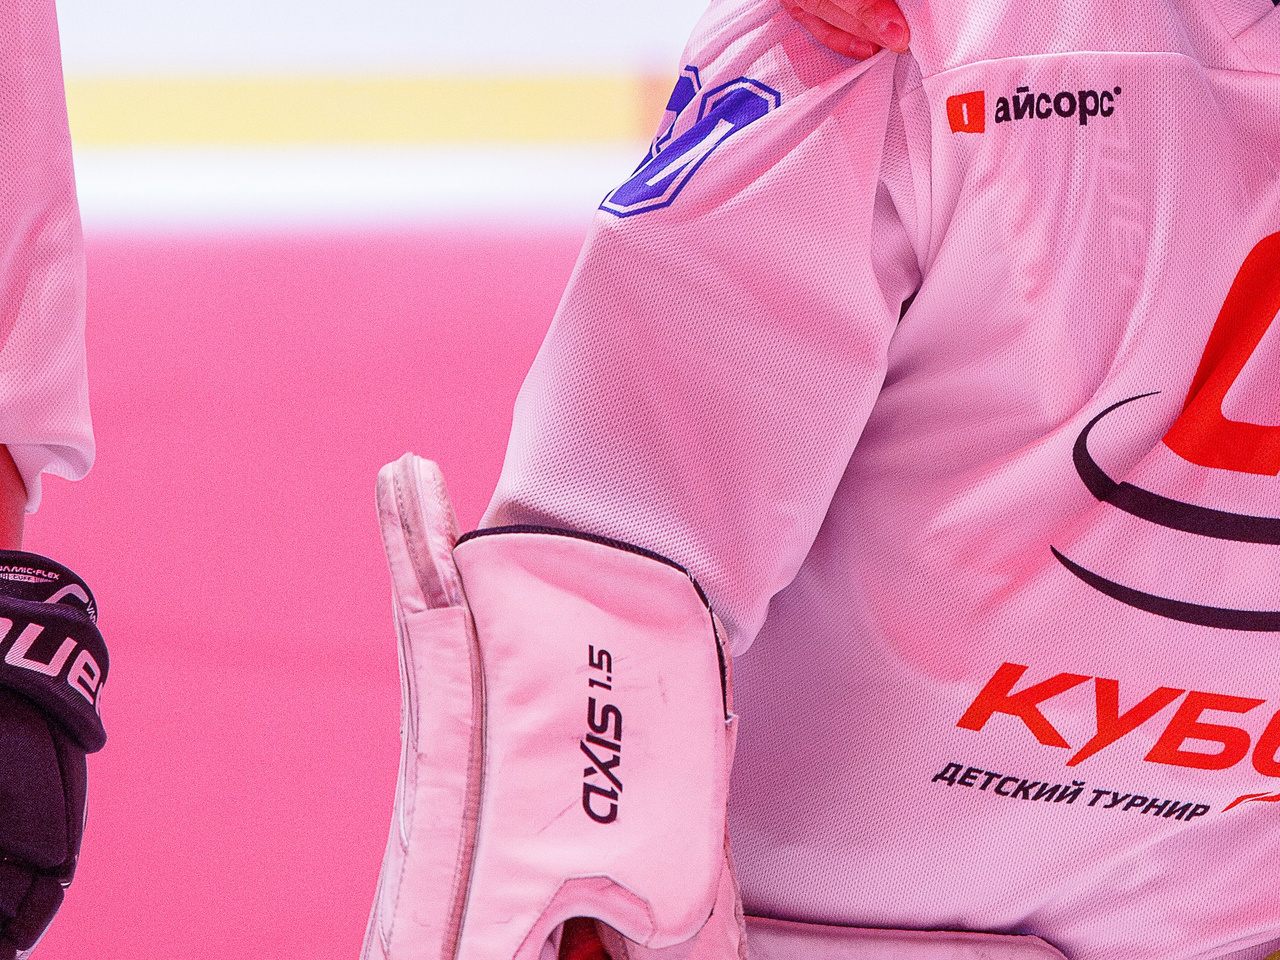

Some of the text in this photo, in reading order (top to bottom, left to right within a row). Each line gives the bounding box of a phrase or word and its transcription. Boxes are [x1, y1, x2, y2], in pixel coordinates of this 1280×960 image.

[994, 86, 1115, 126] айсорс
[588, 644, 613, 691] 1.5
[931, 762, 1211, 822] ДЕТСКИЙ ТУРНИР
